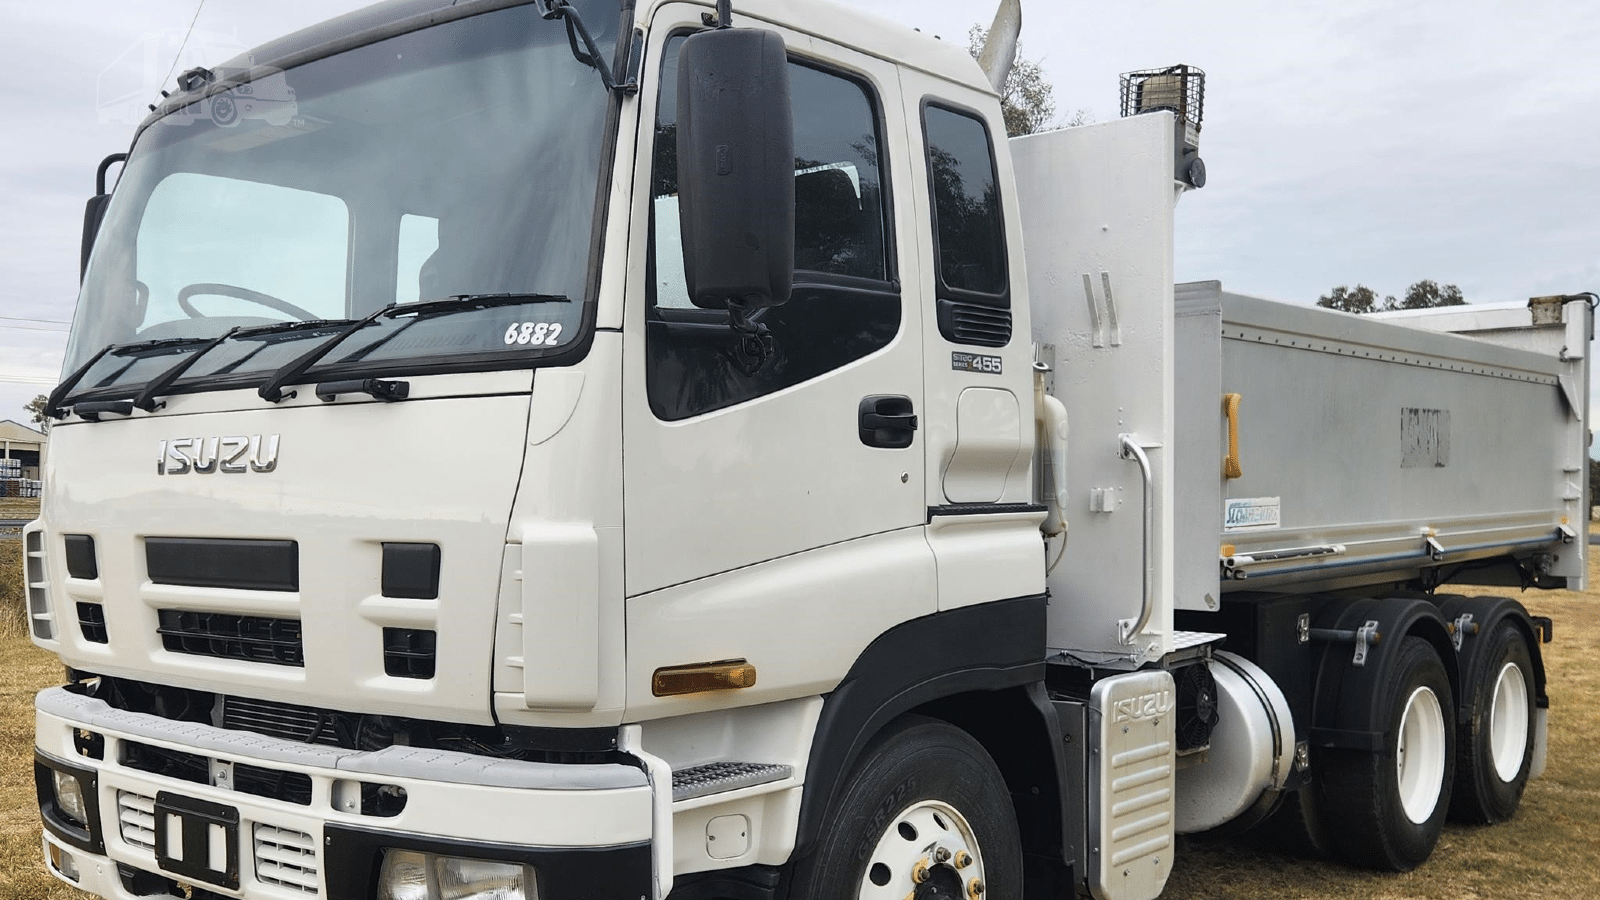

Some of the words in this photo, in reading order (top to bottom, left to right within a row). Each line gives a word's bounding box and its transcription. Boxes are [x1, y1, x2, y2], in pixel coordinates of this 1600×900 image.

[504, 321, 562, 345] 6882
[972, 356, 1001, 373] 455
[158, 433, 280, 475] ISUZU
[1113, 690, 1169, 723] ISUZU
